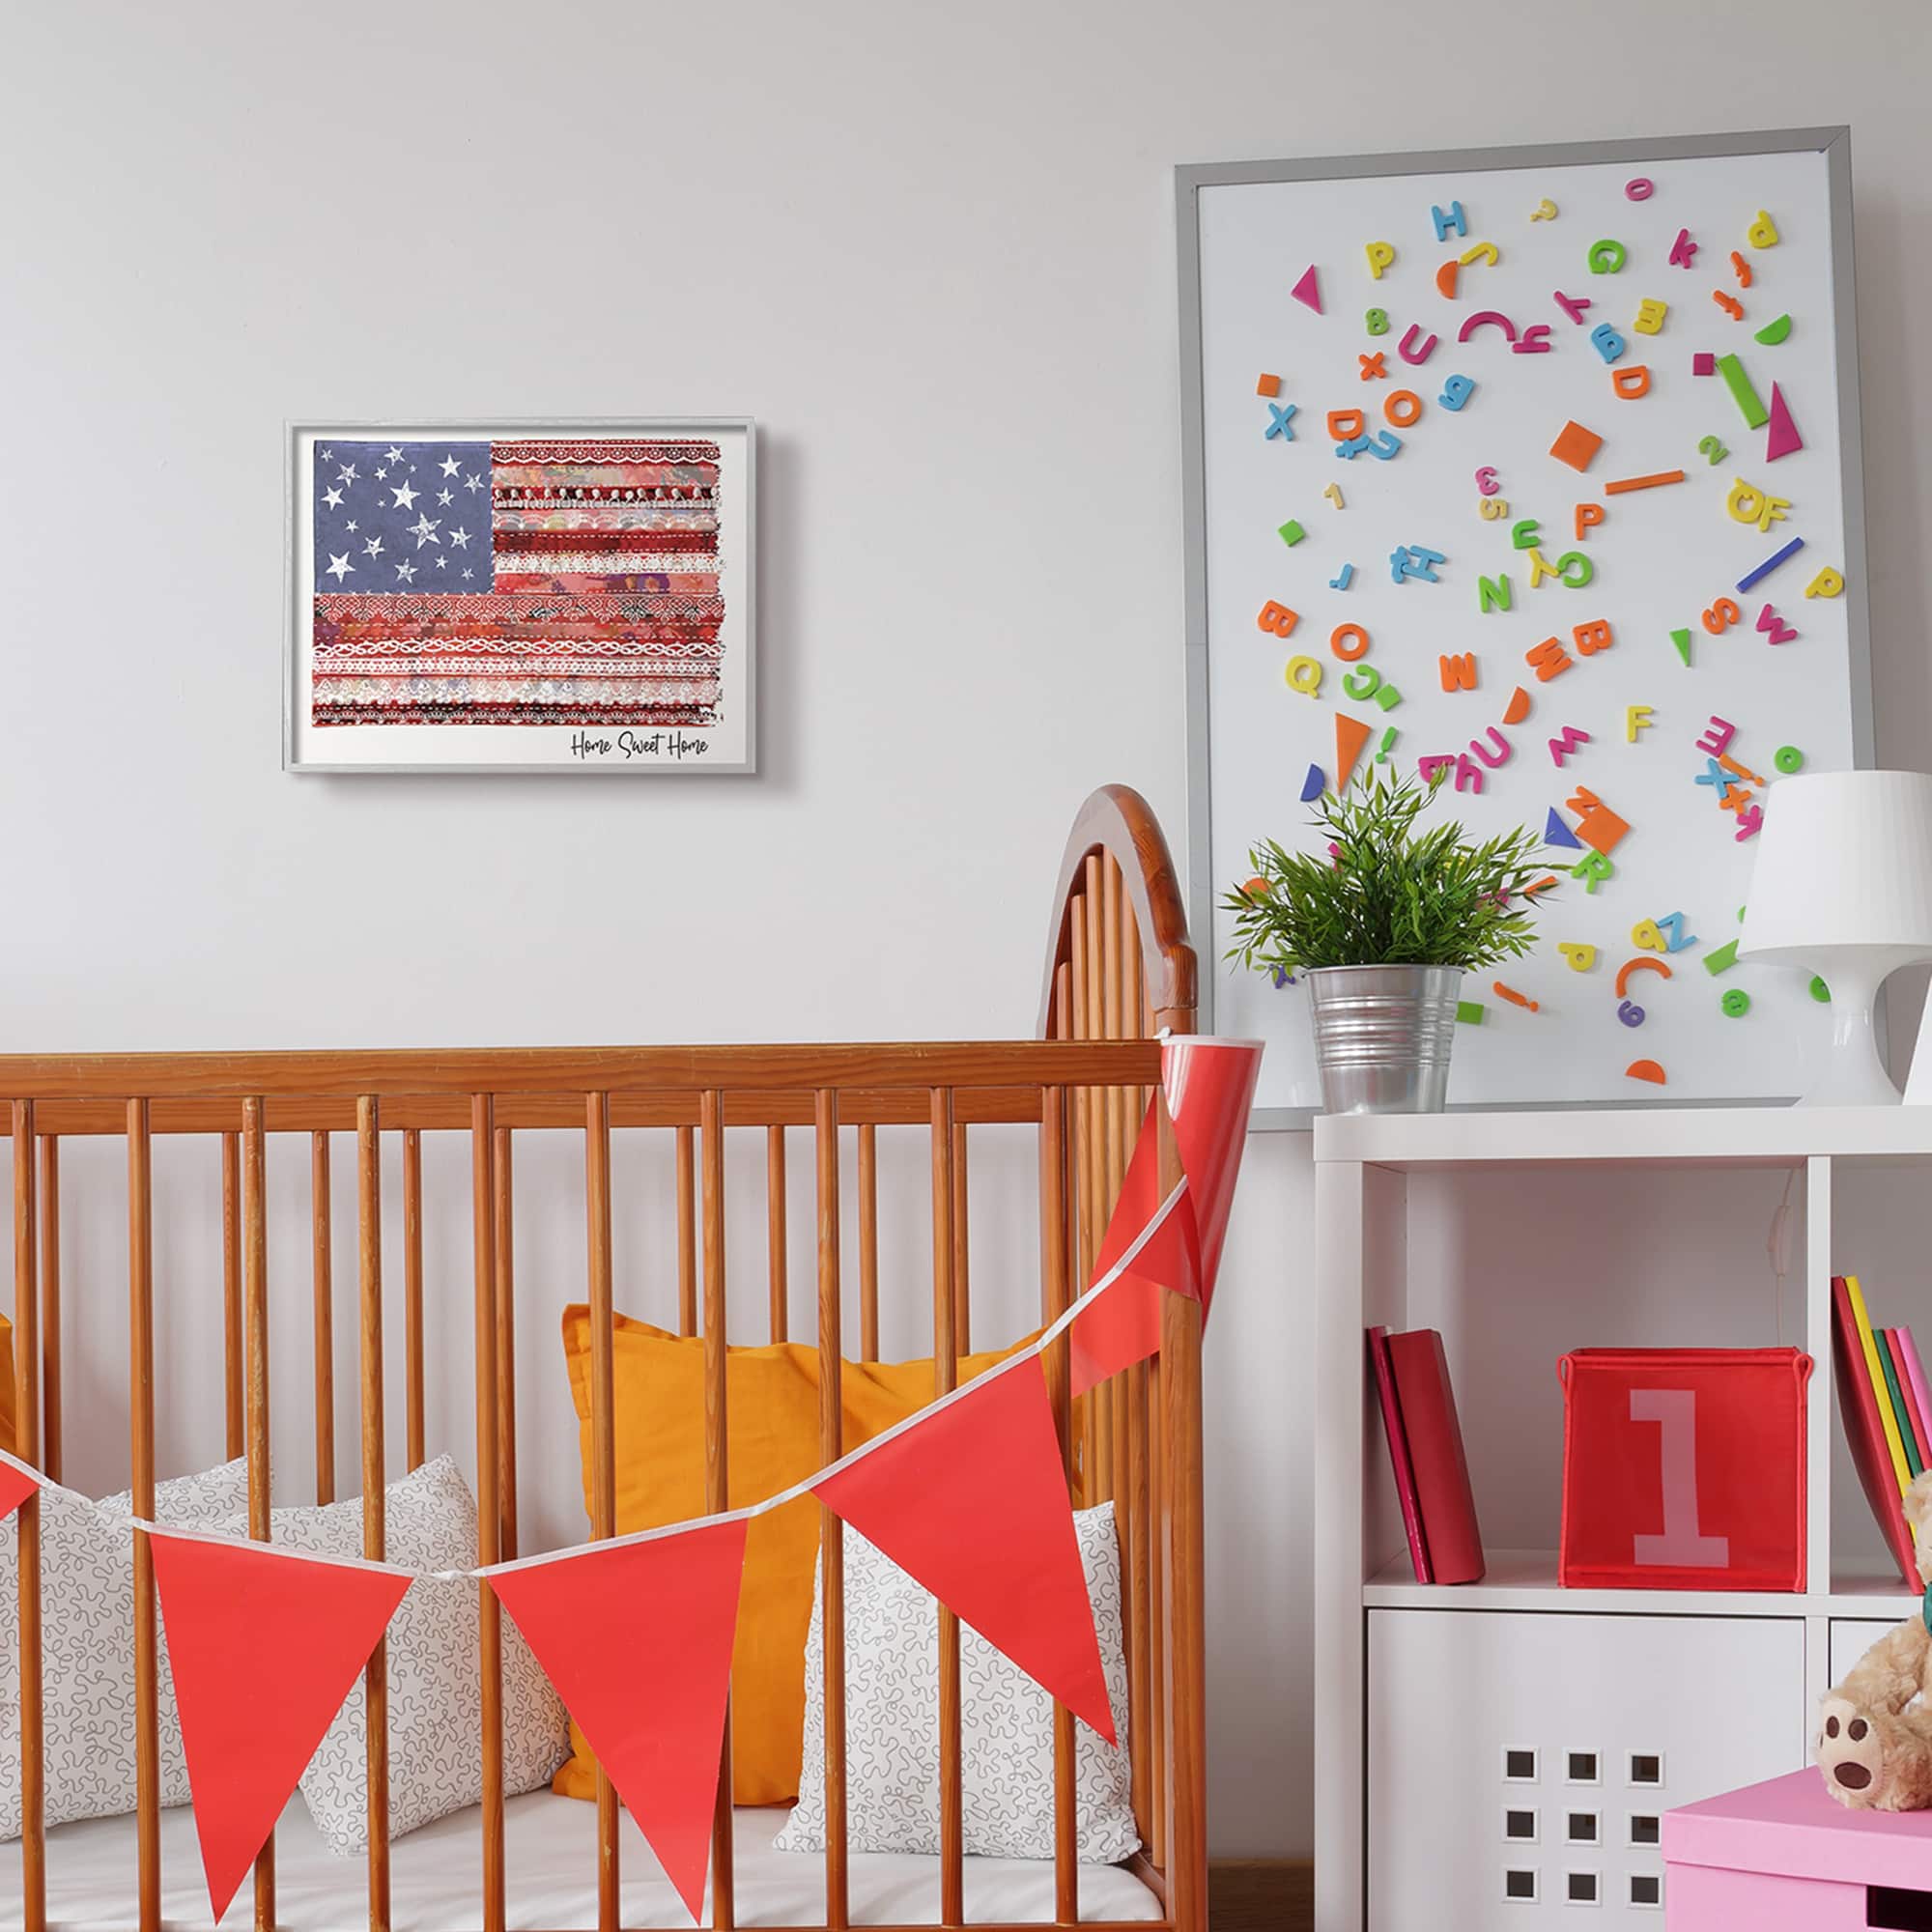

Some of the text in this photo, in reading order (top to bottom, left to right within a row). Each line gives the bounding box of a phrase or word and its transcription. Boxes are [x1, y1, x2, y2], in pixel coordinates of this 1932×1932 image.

[1432, 201, 1467, 242] H
[1478, 574, 1511, 612] N
[1258, 600, 1298, 638] B
[1573, 619, 1613, 656] B
[1285, 655, 1322, 698] Q
[1627, 705, 1653, 743] F
[571, 730, 709, 759] Home Sweet Home
[1571, 850, 1614, 894] R
[1630, 1389, 1728, 1568] 1
